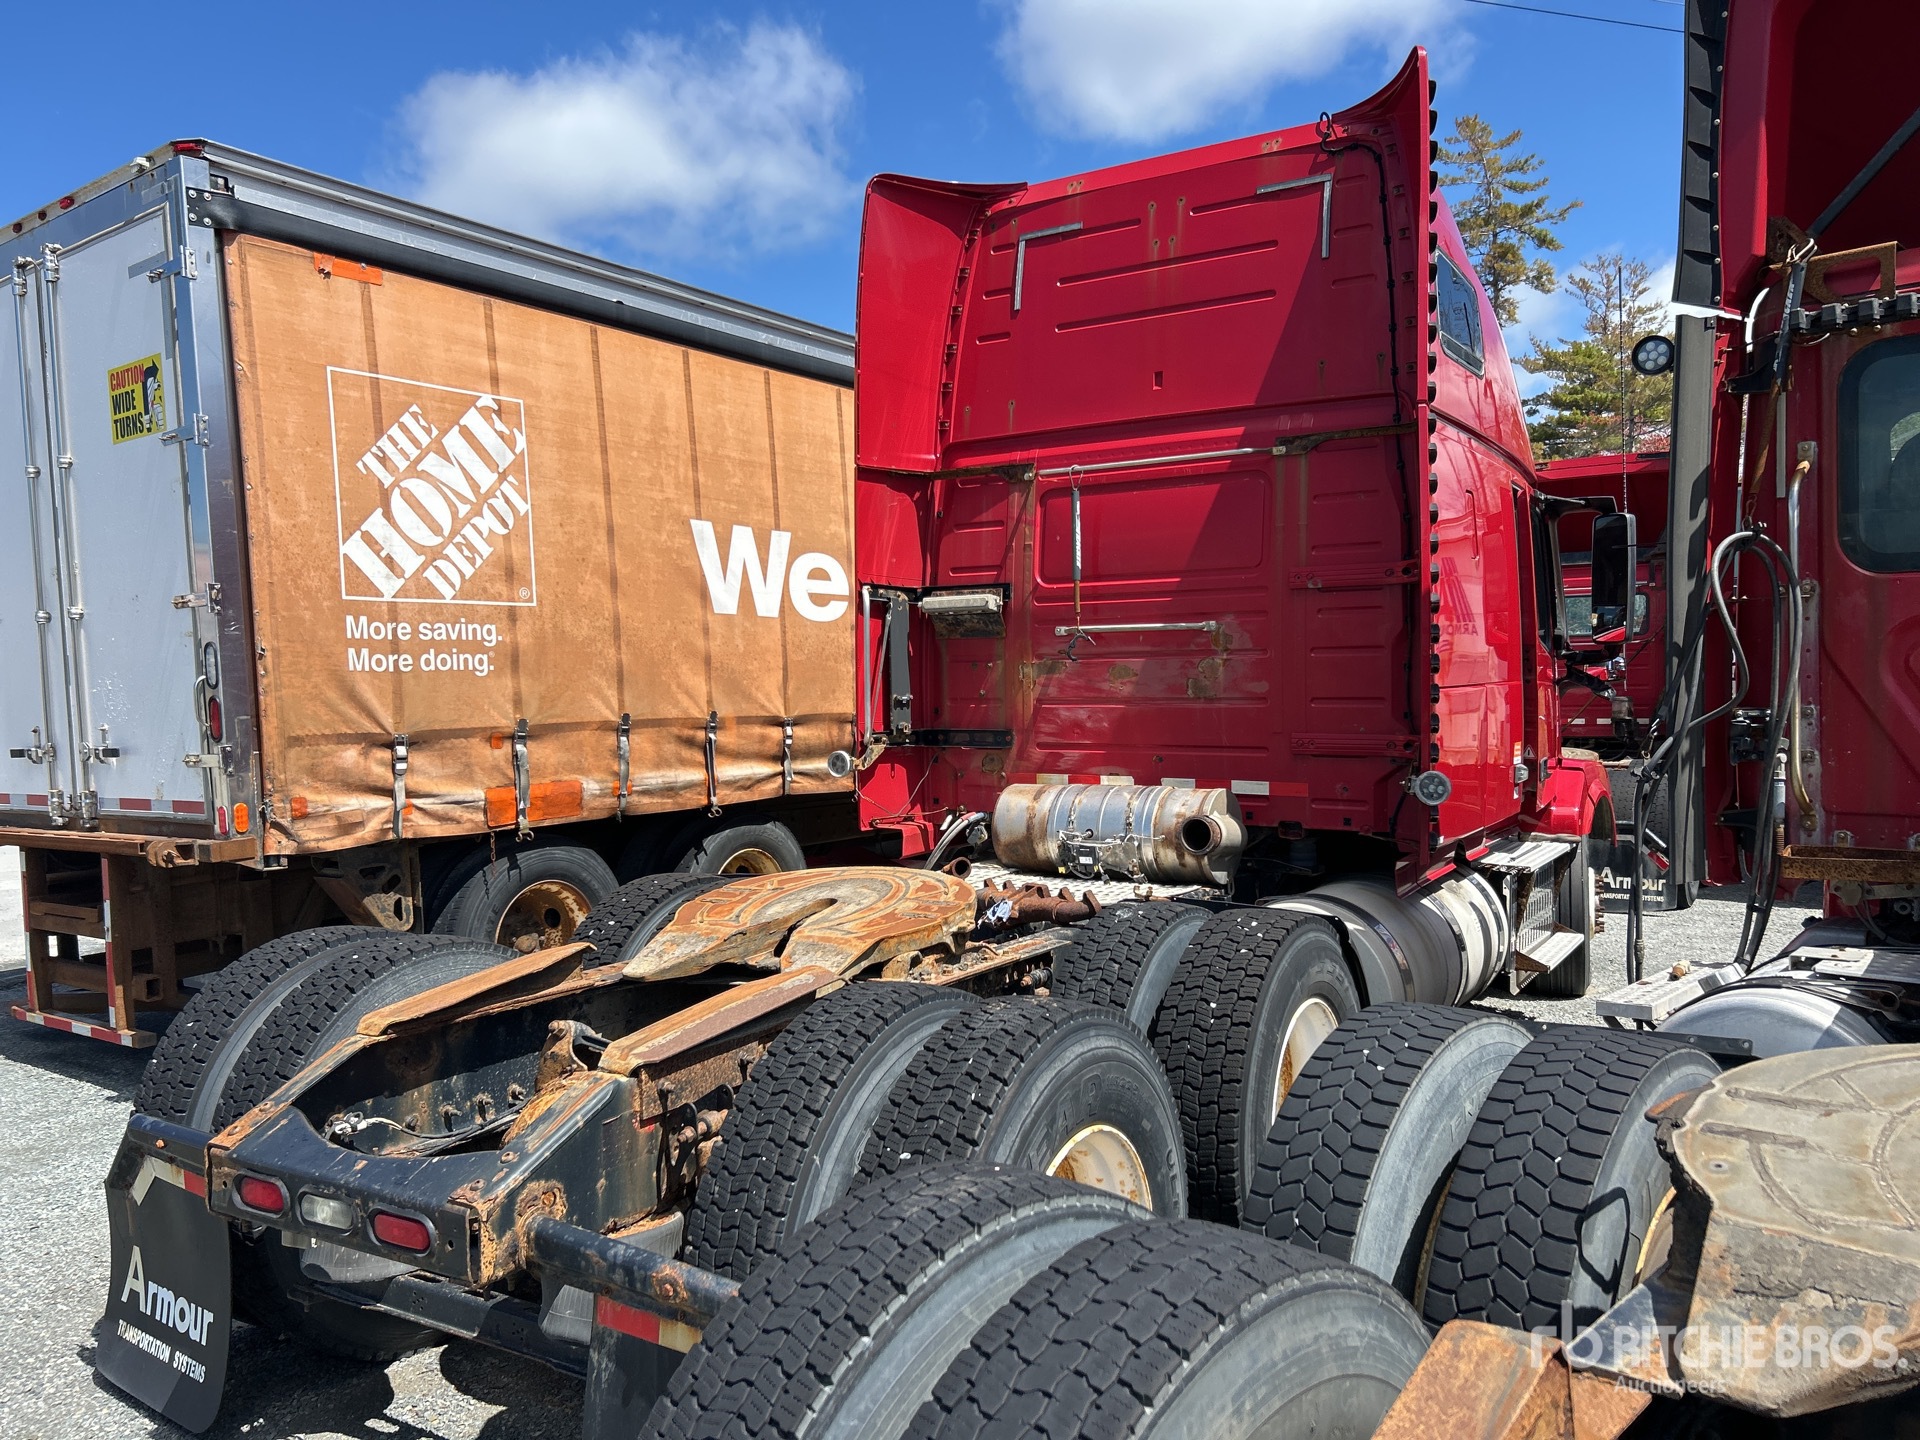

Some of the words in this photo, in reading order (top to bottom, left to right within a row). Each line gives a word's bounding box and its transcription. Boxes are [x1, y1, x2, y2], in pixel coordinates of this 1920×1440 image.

[110, 363, 145, 392] CAUTION
[112, 389, 137, 416] WIDE
[114, 412, 145, 440] TURNS
[356, 403, 439, 489] THE
[341, 395, 525, 600] HOME
[422, 475, 529, 600] DEPOT
[690, 519, 849, 622] We
[345, 615, 412, 640] More
[419, 618, 503, 647] saving.
[347, 648, 413, 672] More
[420, 649, 495, 677] doing.
[121, 1245, 214, 1346] Armour
[117, 1319, 171, 1363] TRANSPORTATION
[172, 1350, 205, 1383] SYSTEMS
